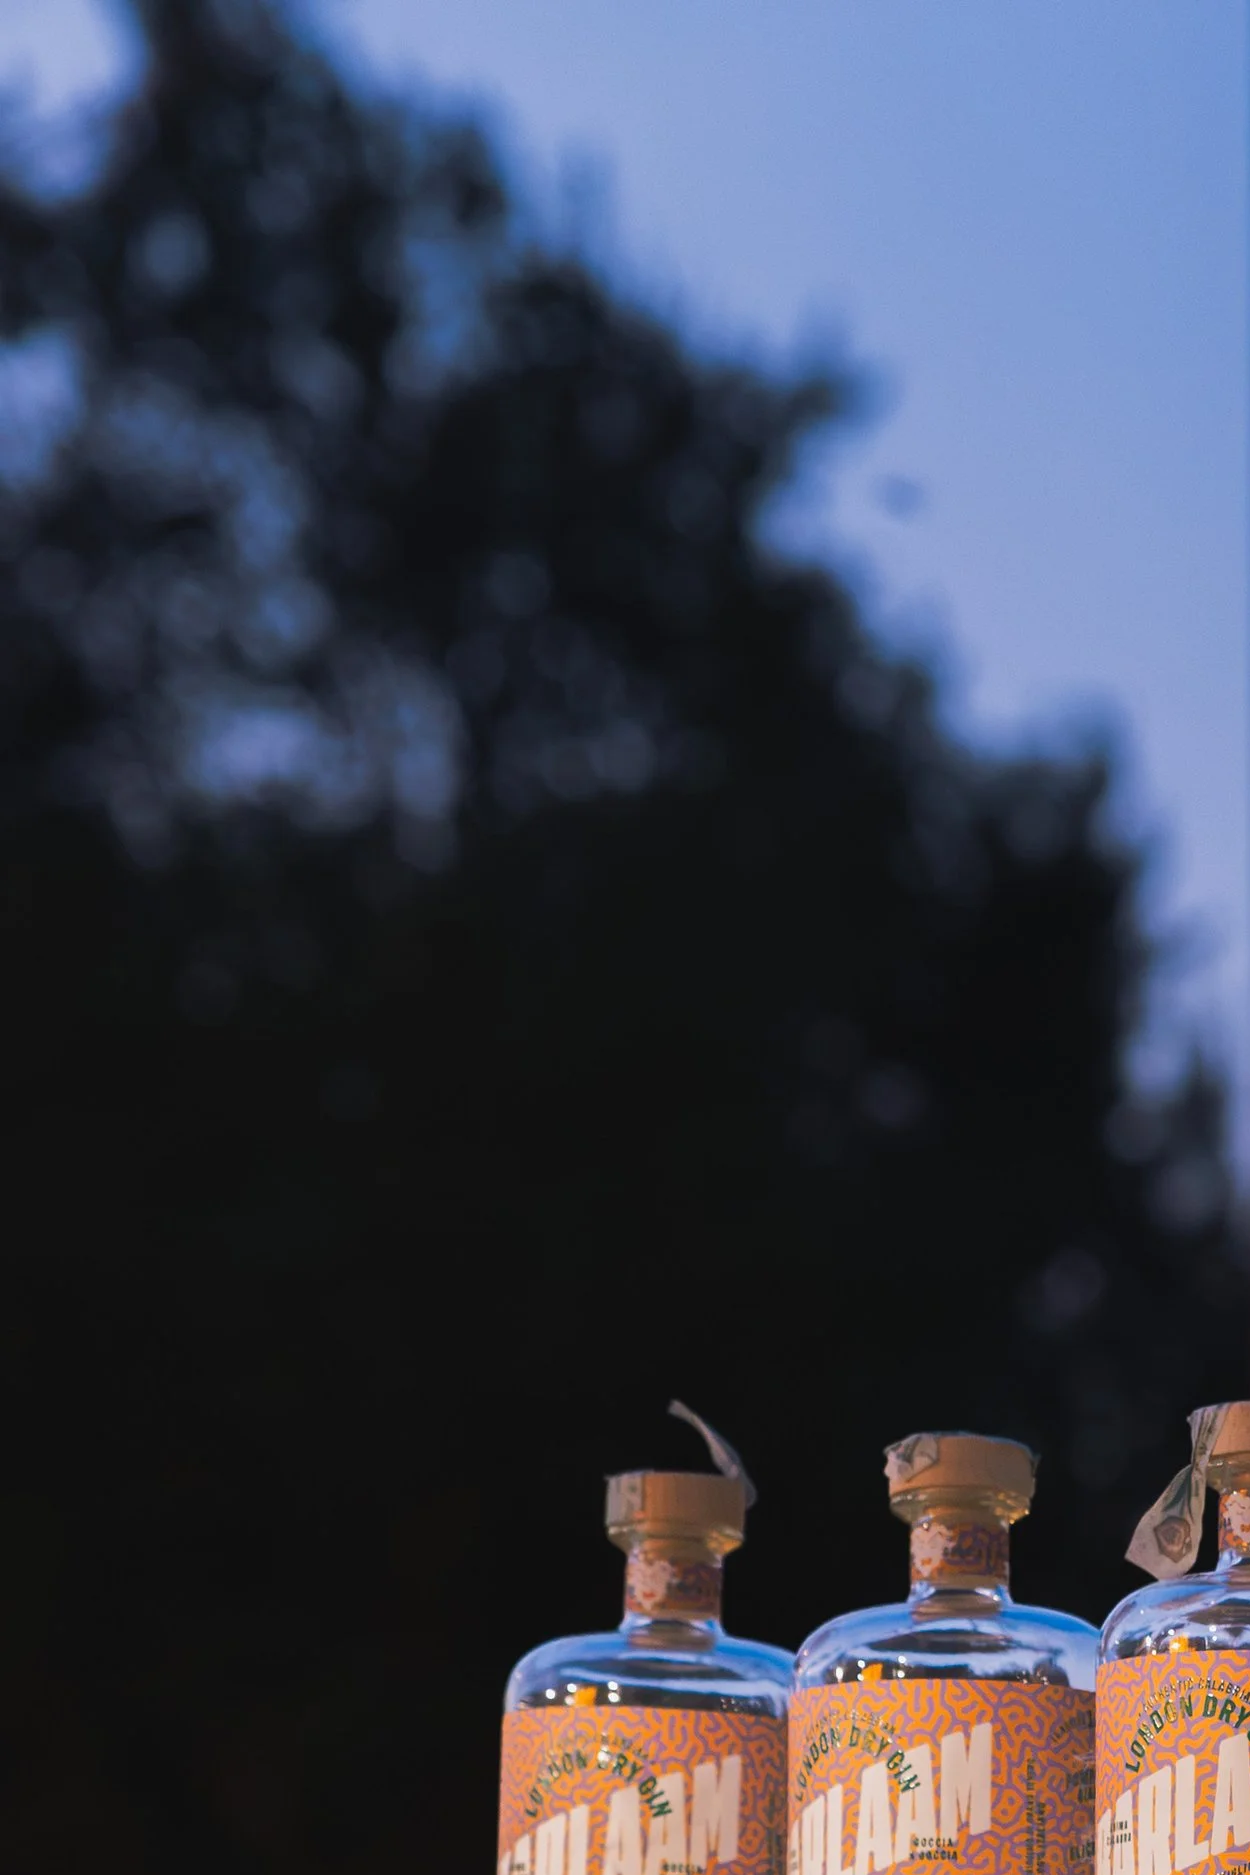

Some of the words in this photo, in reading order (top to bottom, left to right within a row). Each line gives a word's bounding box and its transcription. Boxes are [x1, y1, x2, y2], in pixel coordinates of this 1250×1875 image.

[851, 1725, 891, 1757] DRY
[886, 1749, 921, 1797] GIN
[1125, 1696, 1194, 1773] LONDON
[637, 1776, 672, 1818] GIN
